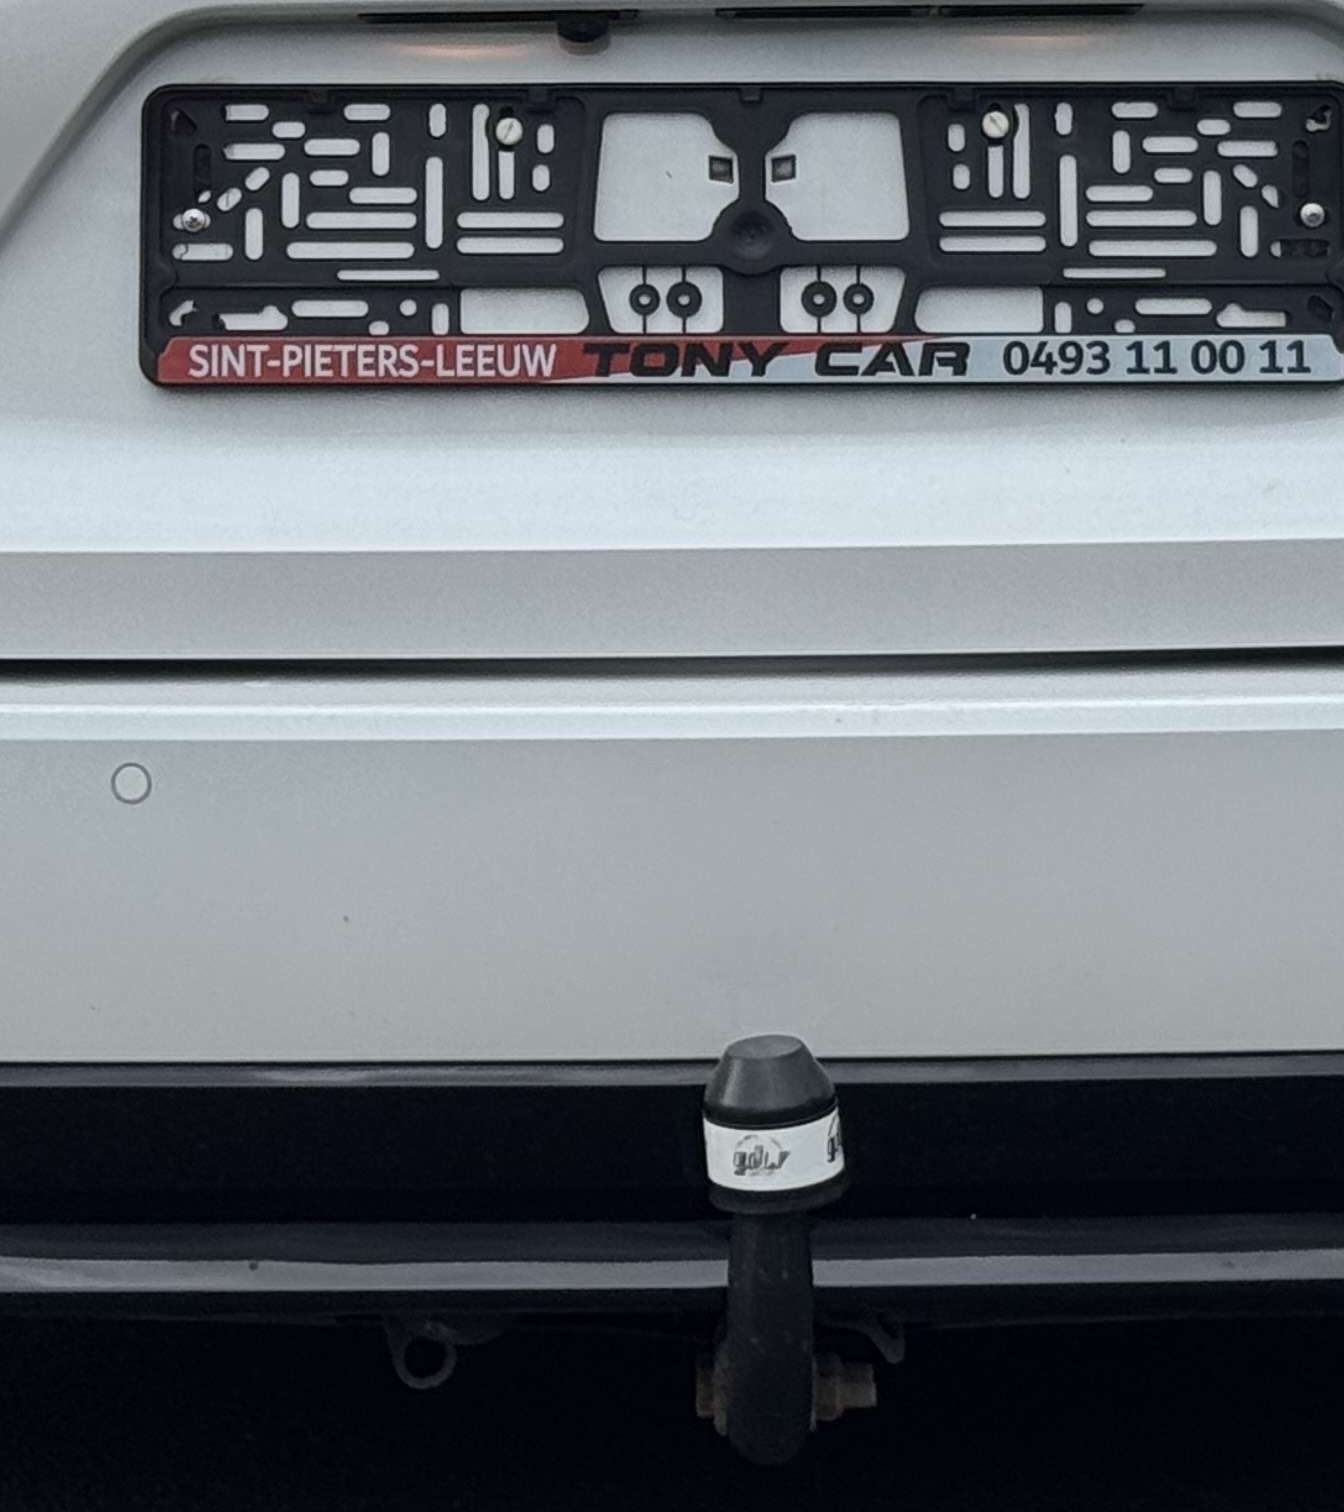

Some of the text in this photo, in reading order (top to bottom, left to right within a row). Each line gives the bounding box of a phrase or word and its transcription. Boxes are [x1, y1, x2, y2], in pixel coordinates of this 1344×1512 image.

[188, 339, 1312, 378] SINT-PIETERS-LEEUW TONY CAR 0493 11 00 11
